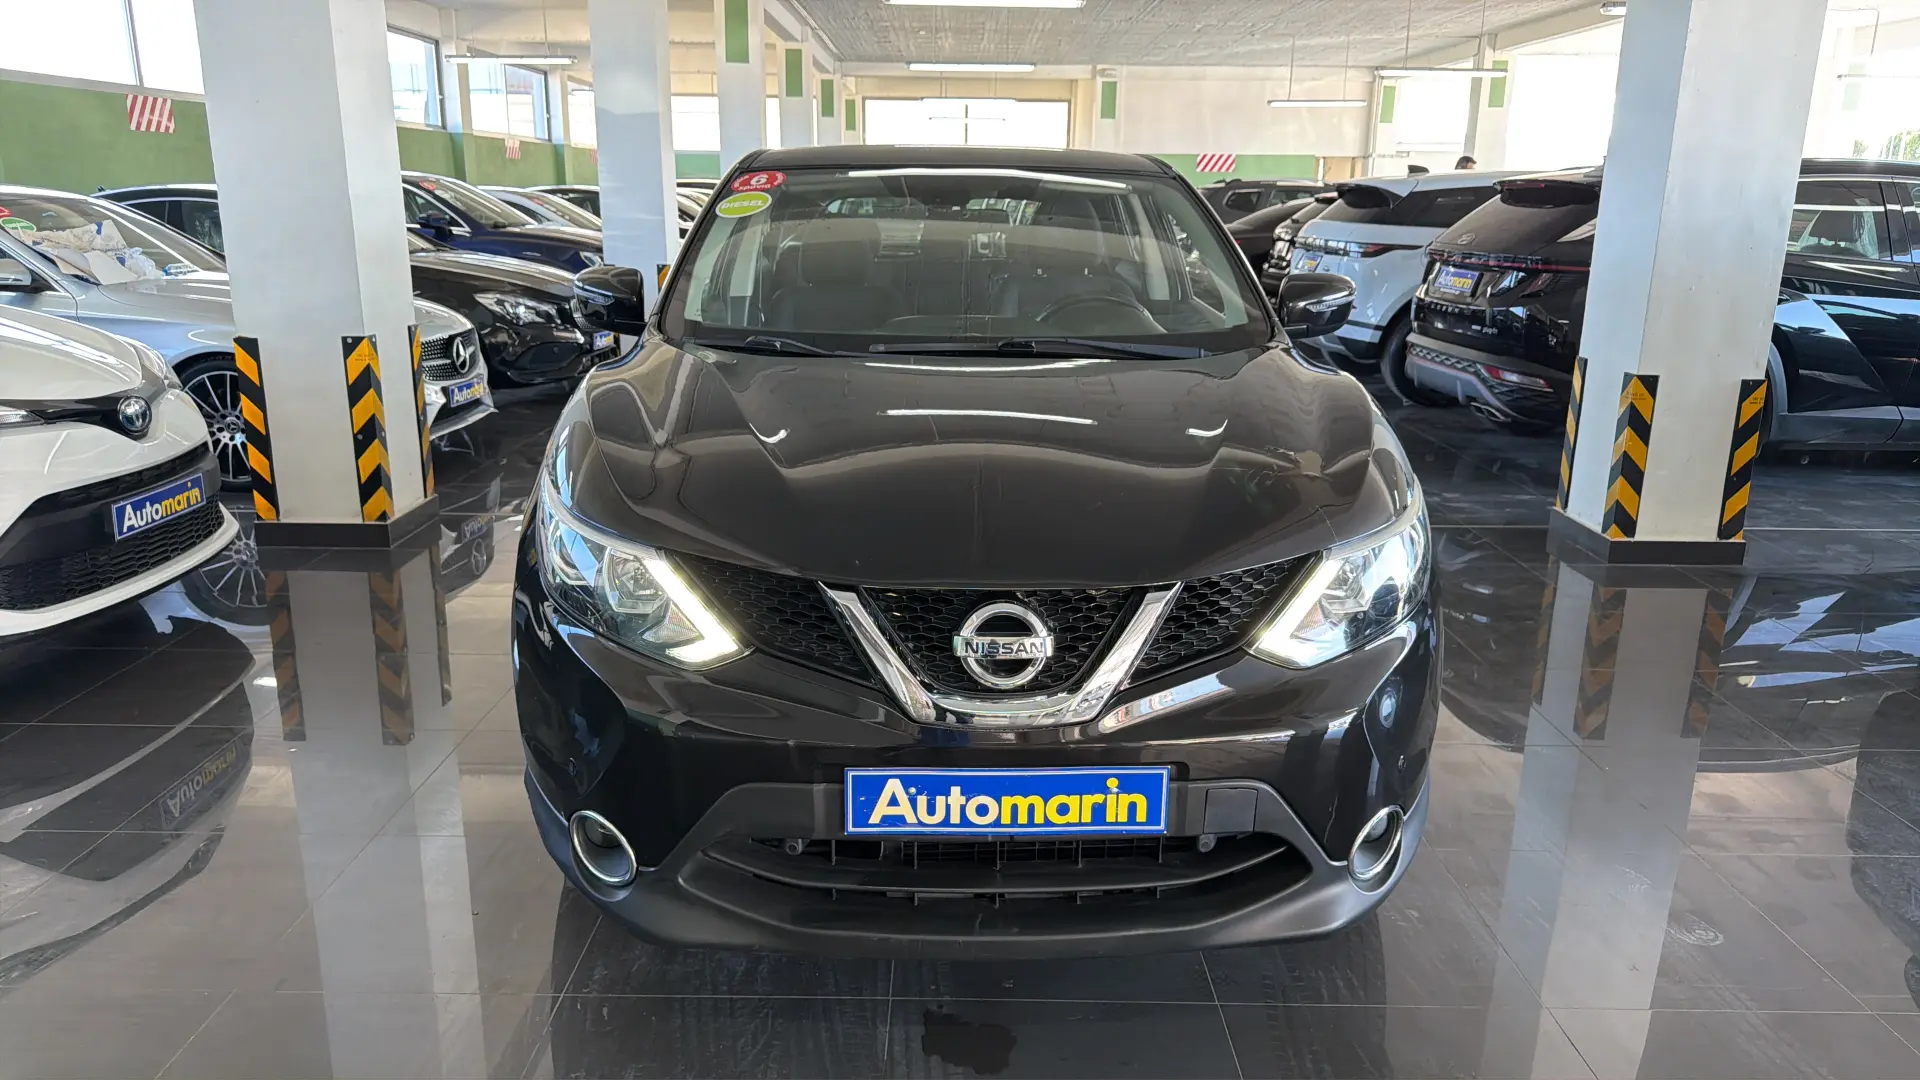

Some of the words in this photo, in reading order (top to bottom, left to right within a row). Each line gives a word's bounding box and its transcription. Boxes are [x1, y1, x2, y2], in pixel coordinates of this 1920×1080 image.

[750, 174, 769, 186] 6
[720, 199, 764, 209] DIESEL
[123, 481, 201, 533] Automarin
[964, 641, 1043, 654] NISSAN
[868, 777, 1147, 825] Automarin
